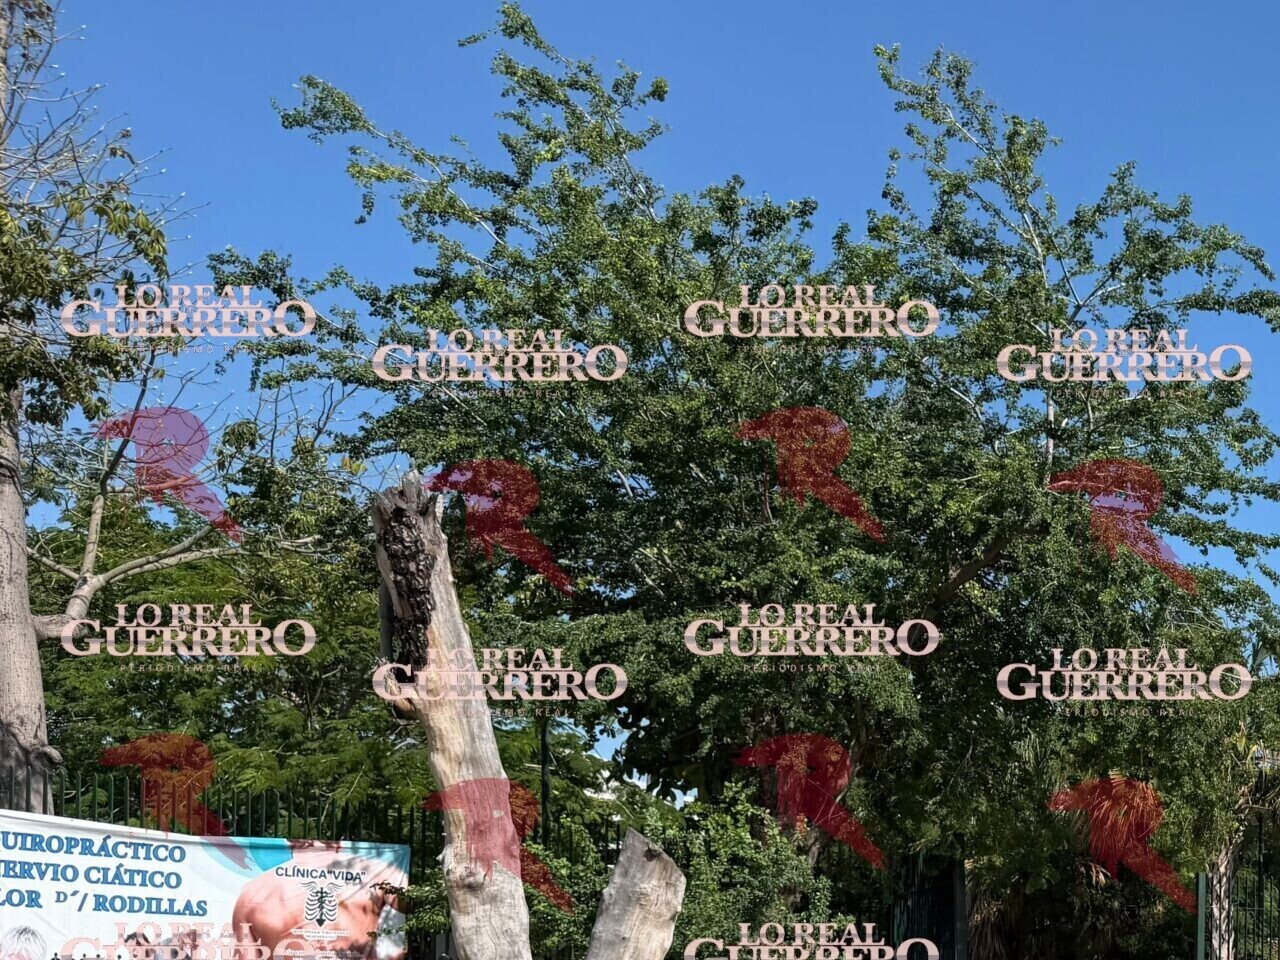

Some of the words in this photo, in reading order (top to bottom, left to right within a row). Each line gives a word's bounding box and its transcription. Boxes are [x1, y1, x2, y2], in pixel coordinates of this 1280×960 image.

[0, 831, 186, 863] UIROPRÁCTICO
[83, 863, 182, 889] CIÁTICO
[92, 894, 208, 916] RODILLAS
